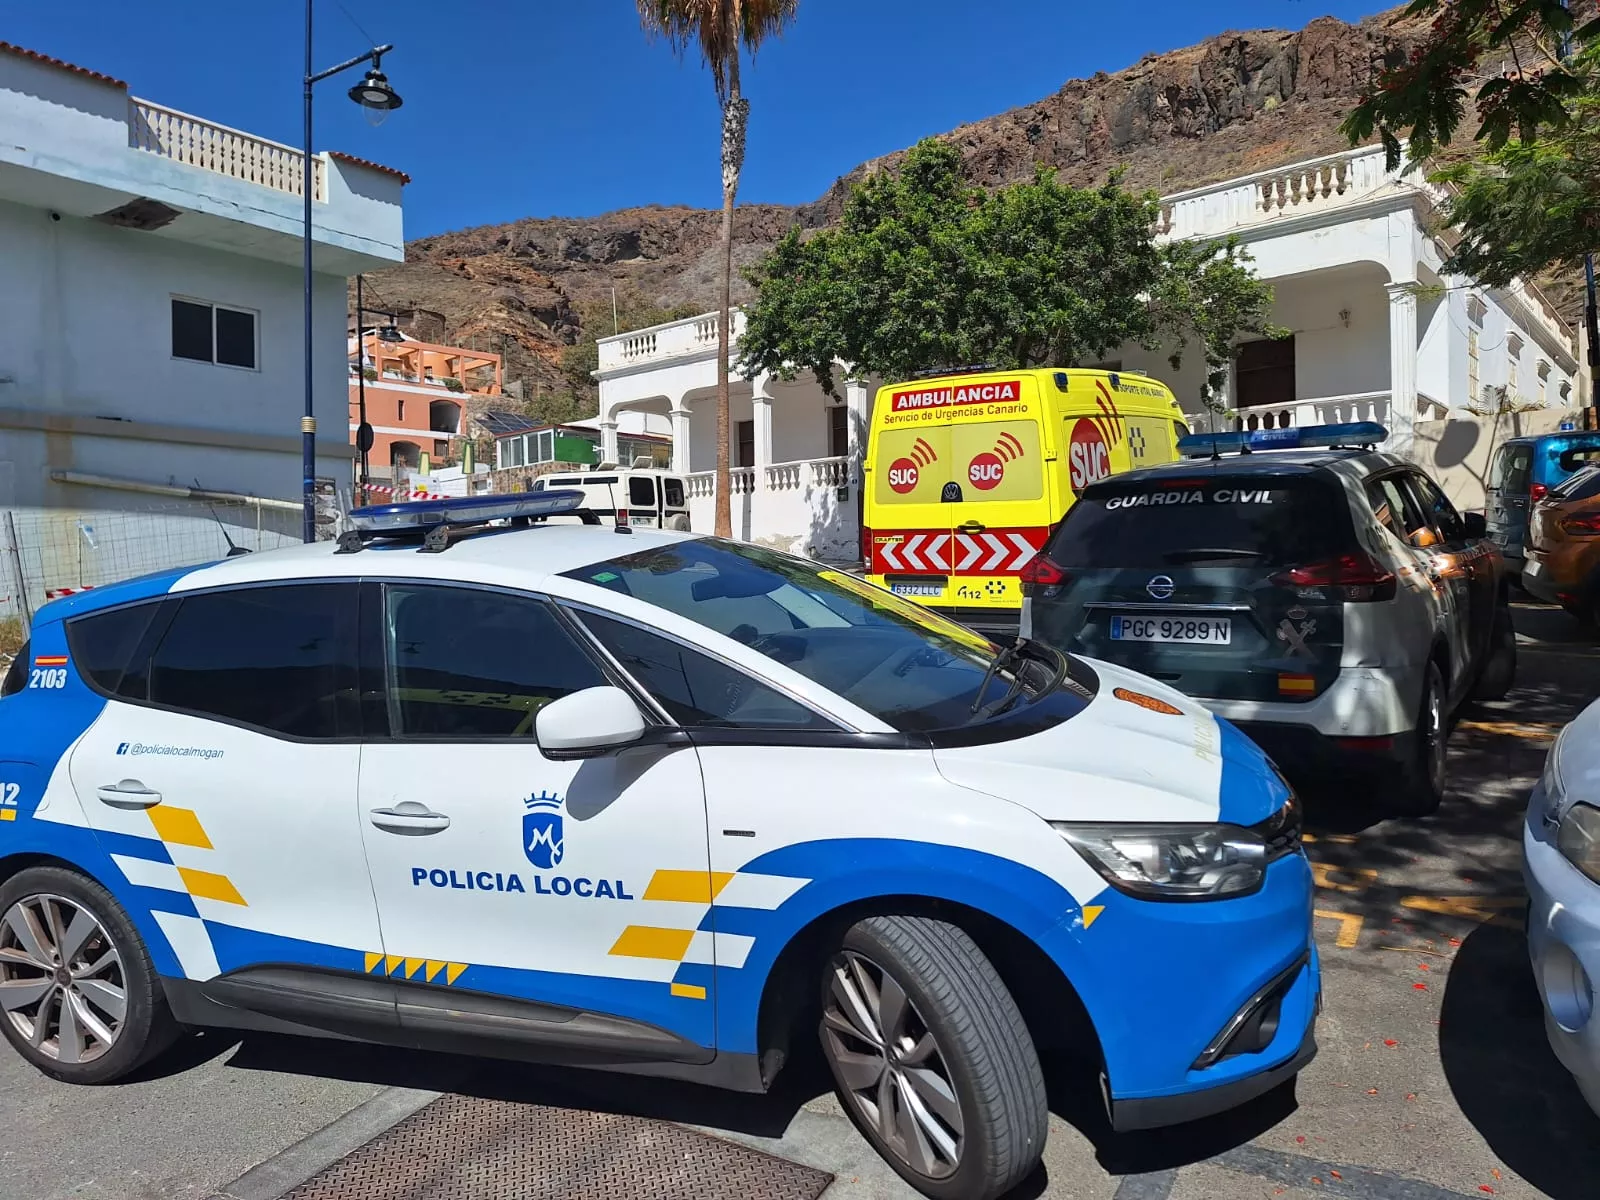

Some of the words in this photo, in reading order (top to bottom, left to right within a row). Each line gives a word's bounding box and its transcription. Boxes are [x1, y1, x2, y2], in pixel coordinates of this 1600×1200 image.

[897, 384, 1014, 409] AMBULANCIA
[884, 412, 919, 425] Servicio
[921, 411, 933, 421] de
[935, 407, 984, 421] Urgencias
[987, 403, 1028, 415] Canario
[969, 463, 1002, 481] SUC
[1071, 442, 1109, 488] SUC
[889, 468, 917, 485] SUC
[1106, 490, 1203, 510] GUARDIA
[1213, 490, 1273, 504] CIVIL
[896, 584, 920, 595] 6332
[921, 585, 940, 595] LLC
[962, 591, 981, 599] 112
[1121, 619, 1156, 638] PGC
[1161, 620, 1210, 640] 9289
[1215, 622, 1228, 641] N
[29, 669, 67, 689] 2103
[130, 743, 224, 760] @policialocalmogan
[411, 867, 526, 893] POLICIA
[533, 875, 634, 901] LOCAL
